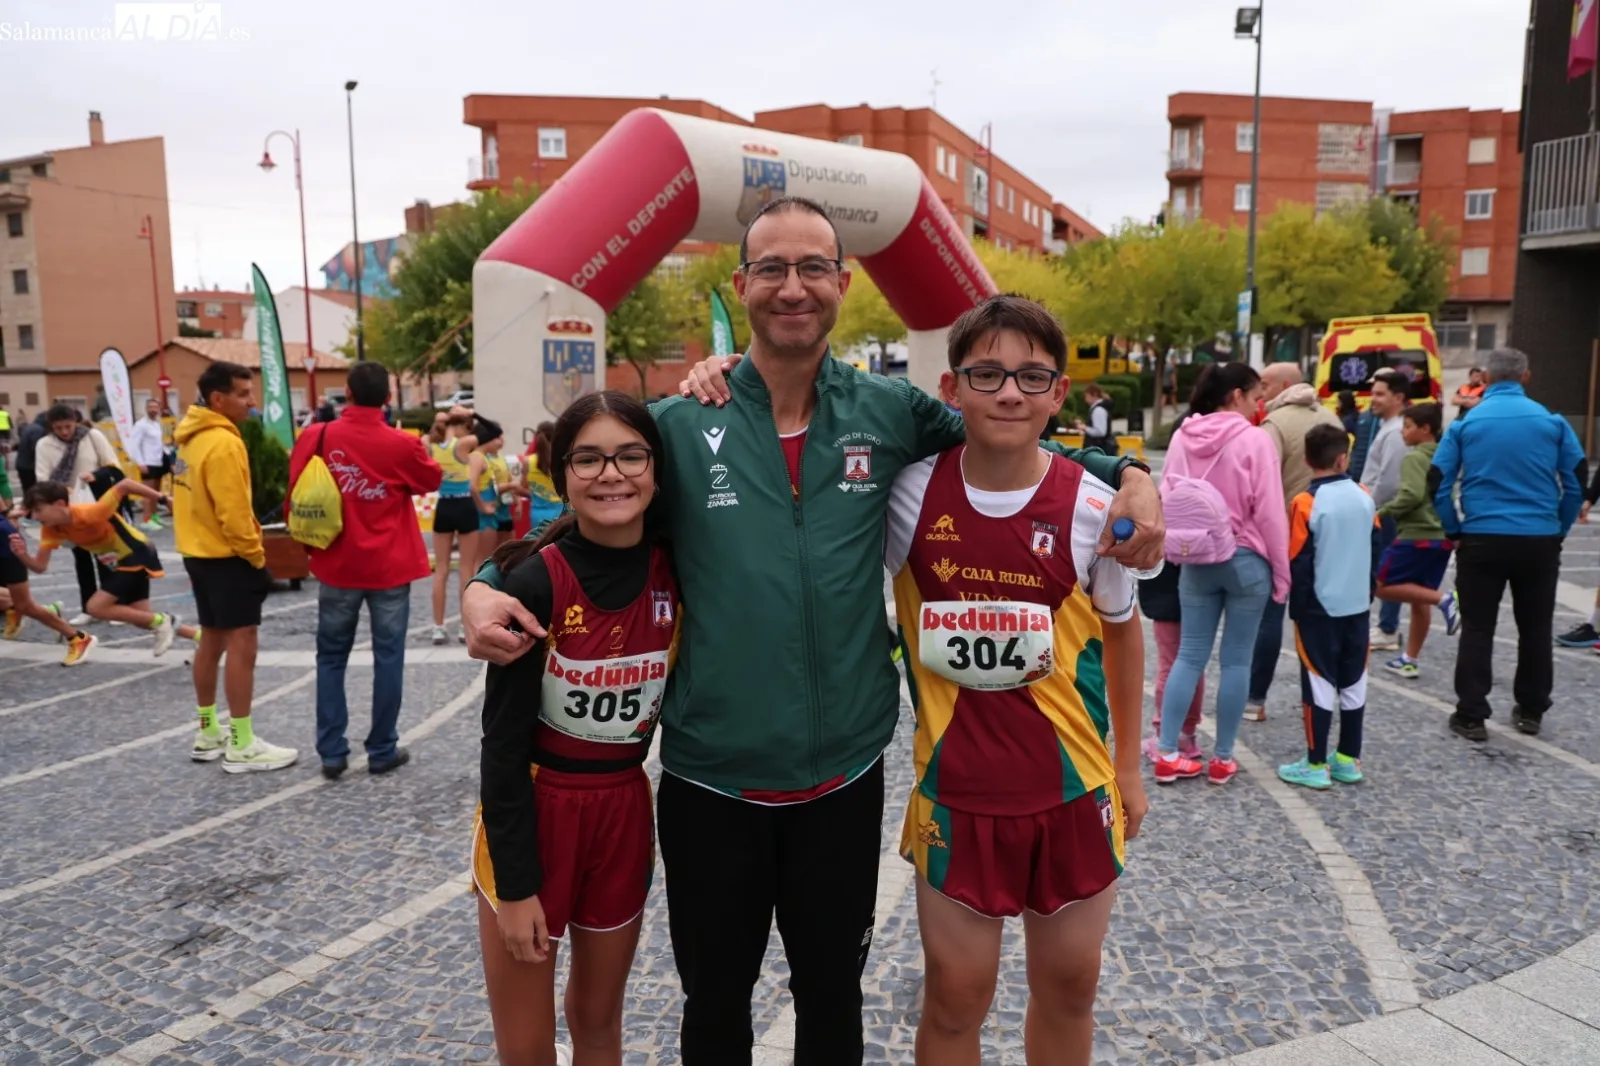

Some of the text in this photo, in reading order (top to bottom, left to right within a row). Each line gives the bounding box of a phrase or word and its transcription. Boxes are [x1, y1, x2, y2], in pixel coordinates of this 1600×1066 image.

[570, 165, 695, 290] CON EL DEPORTE
[832, 433, 852, 449] VINO
[851, 431, 863, 440] DE
[863, 431, 882, 446] TORO
[706, 498, 740, 509] ZAMORA
[961, 567, 1045, 590] CAJA RURAL
[922, 607, 1051, 633] bedunia
[946, 635, 1027, 672] 304
[547, 653, 666, 688] bedunia
[563, 687, 643, 723] 305
